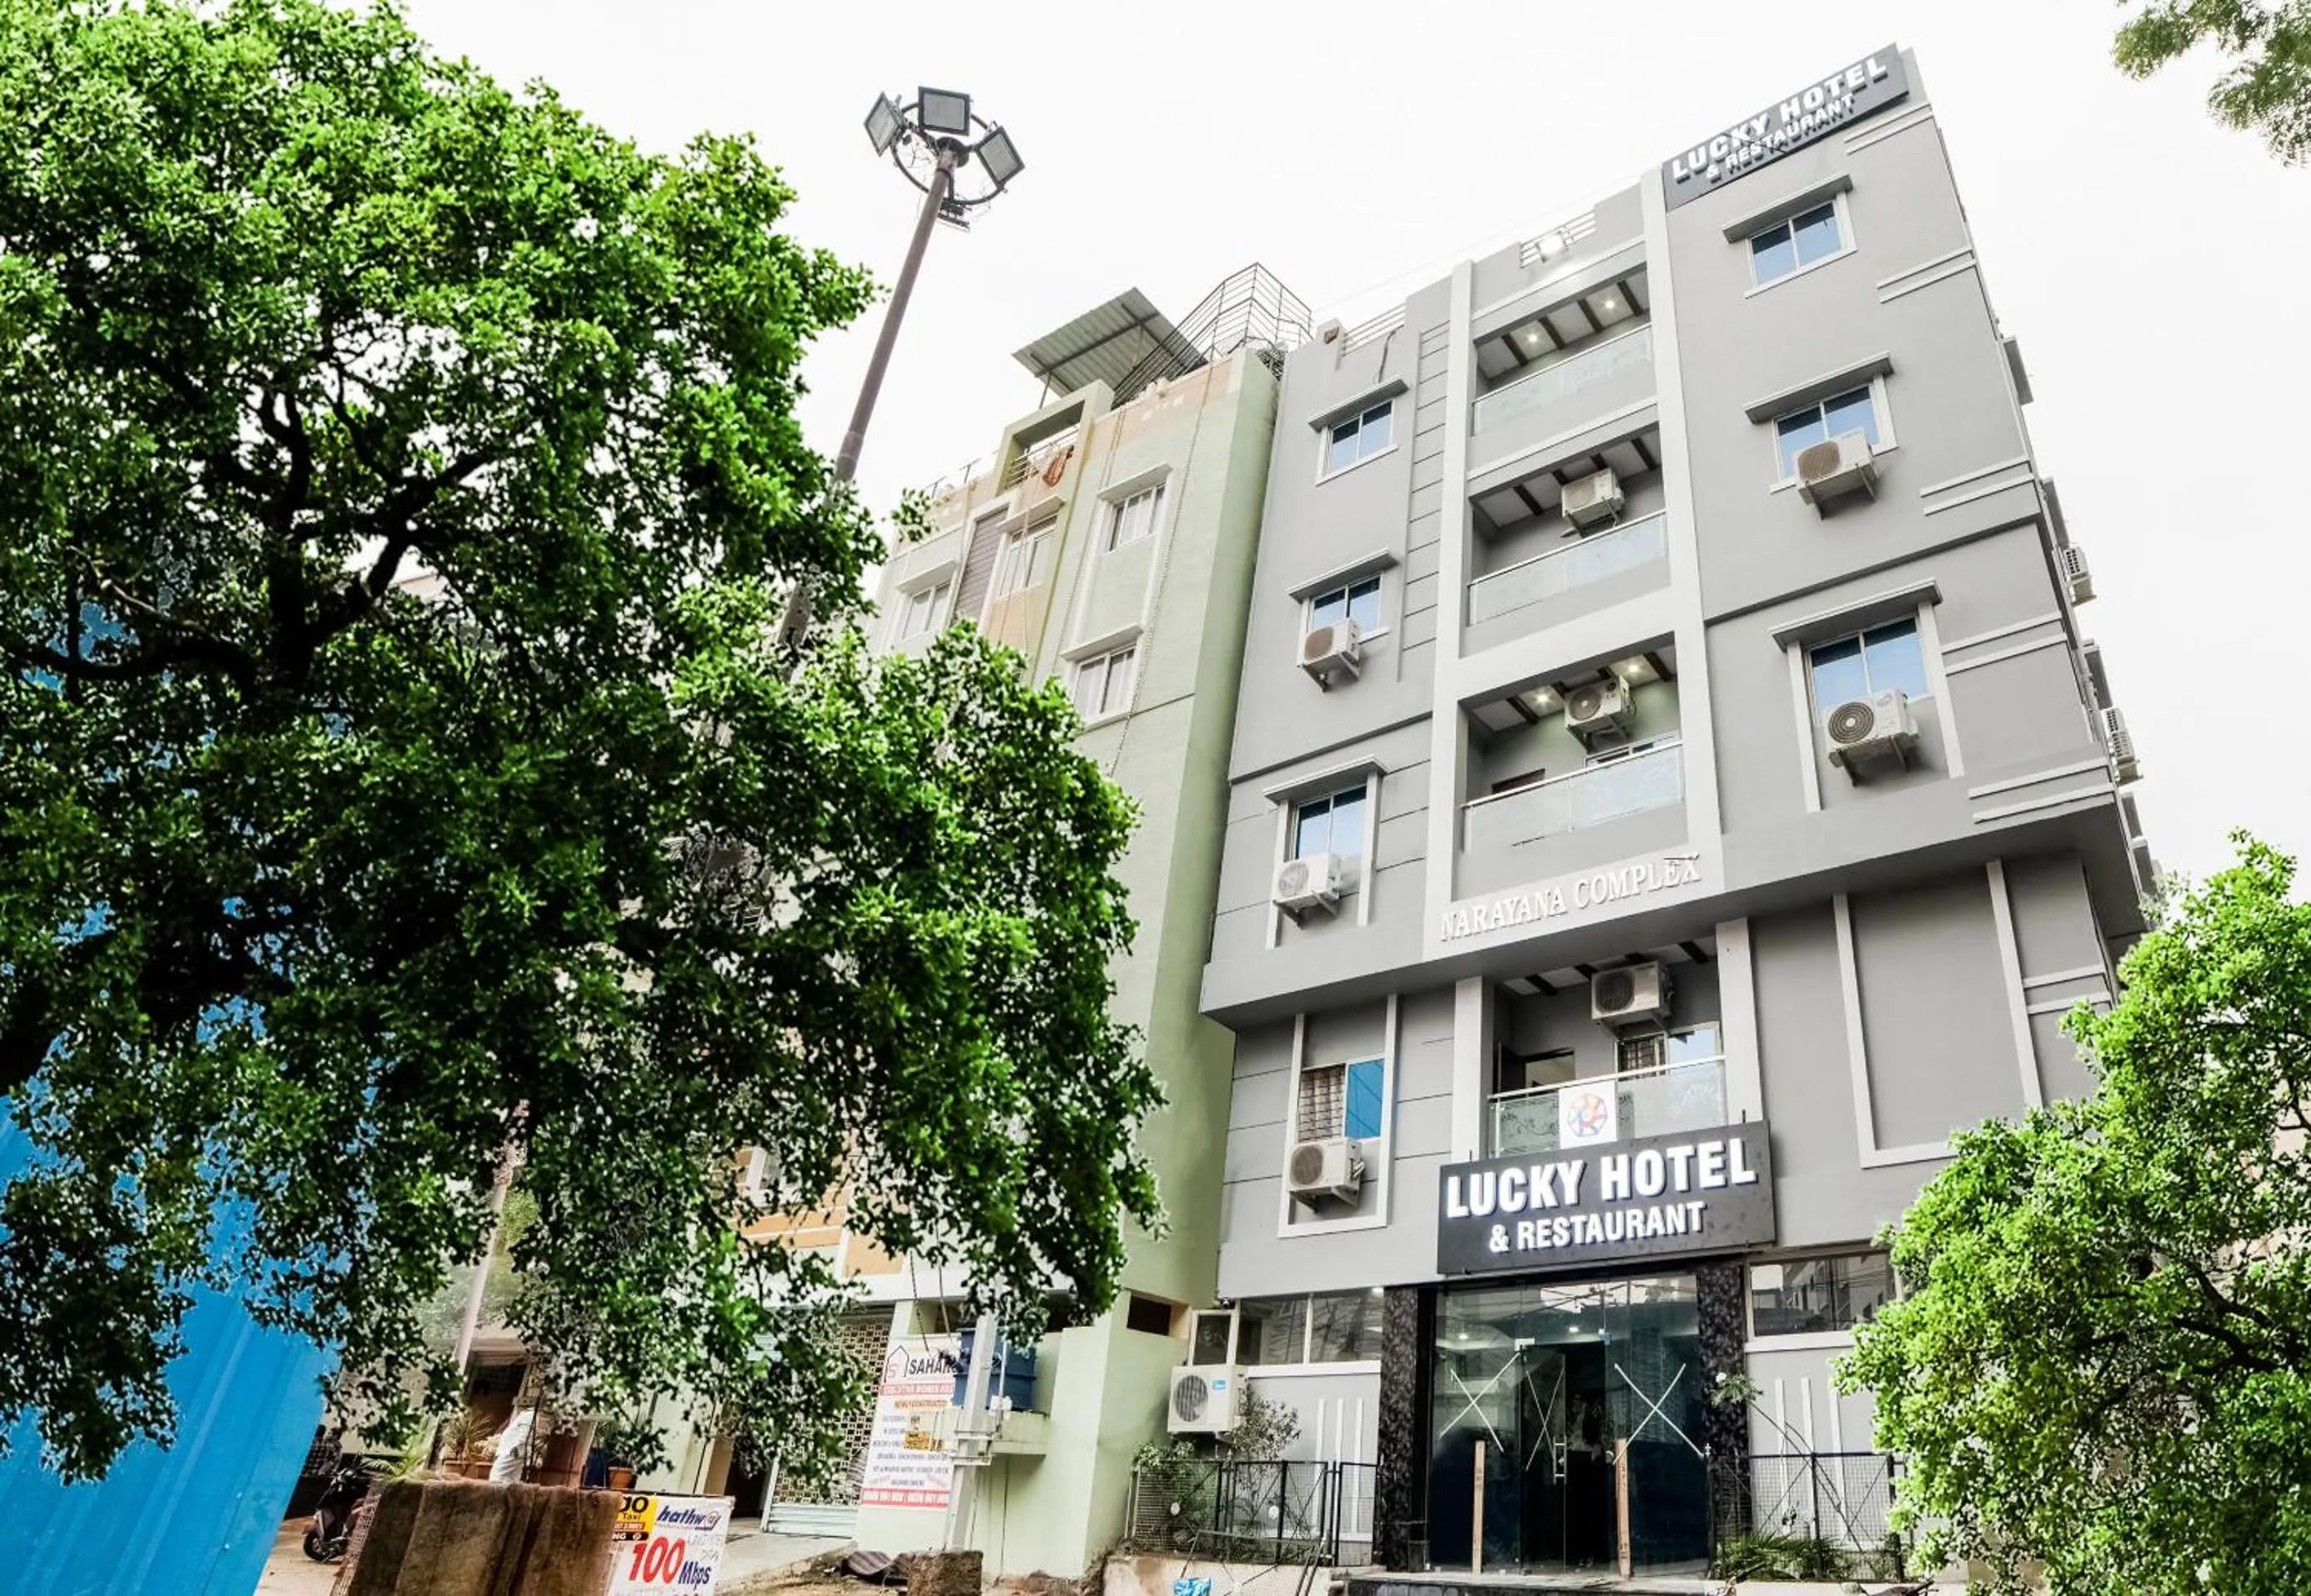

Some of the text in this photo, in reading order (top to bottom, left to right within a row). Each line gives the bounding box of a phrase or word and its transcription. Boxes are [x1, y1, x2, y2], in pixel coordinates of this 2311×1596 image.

[1672, 57, 1888, 182] LUCKY HOTEL
[1706, 92, 1855, 183] & RESTAURANT
[1441, 856, 1702, 941] NARAYANA COMPLEX
[1446, 1138, 1758, 1219] LUCKY HOTEL
[1490, 1200, 1707, 1253] & RESTAURANT
[628, 1536, 712, 1589] 100 Mbps
